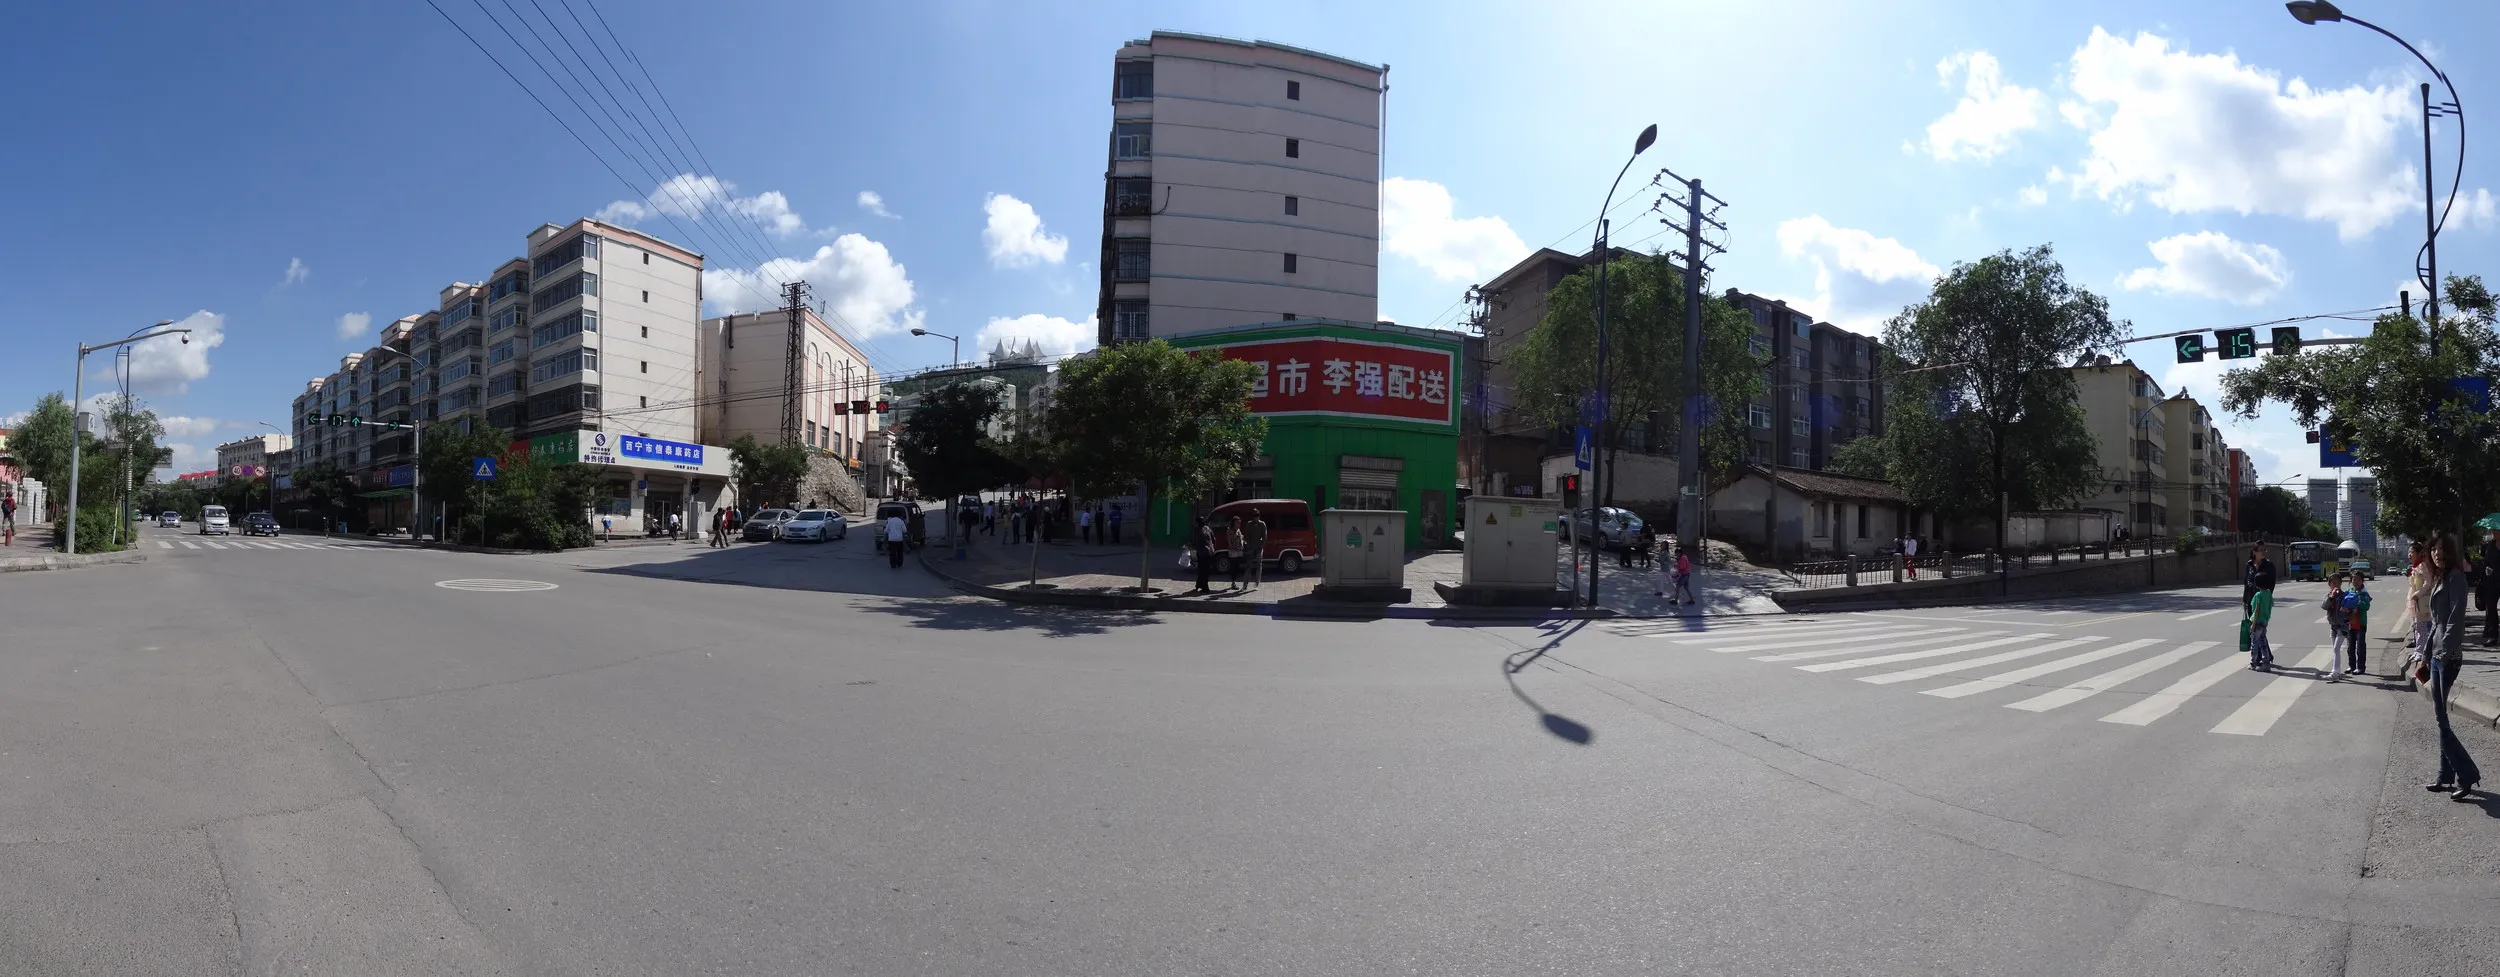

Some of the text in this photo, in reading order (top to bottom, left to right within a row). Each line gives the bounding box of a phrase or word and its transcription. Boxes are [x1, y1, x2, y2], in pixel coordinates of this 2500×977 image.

[2231, 332, 2252, 358] 15
[1322, 357, 1446, 405] 李强配送
[332, 416, 342, 425] 17
[625, 440, 700, 459] 西宁市信泰康药店
